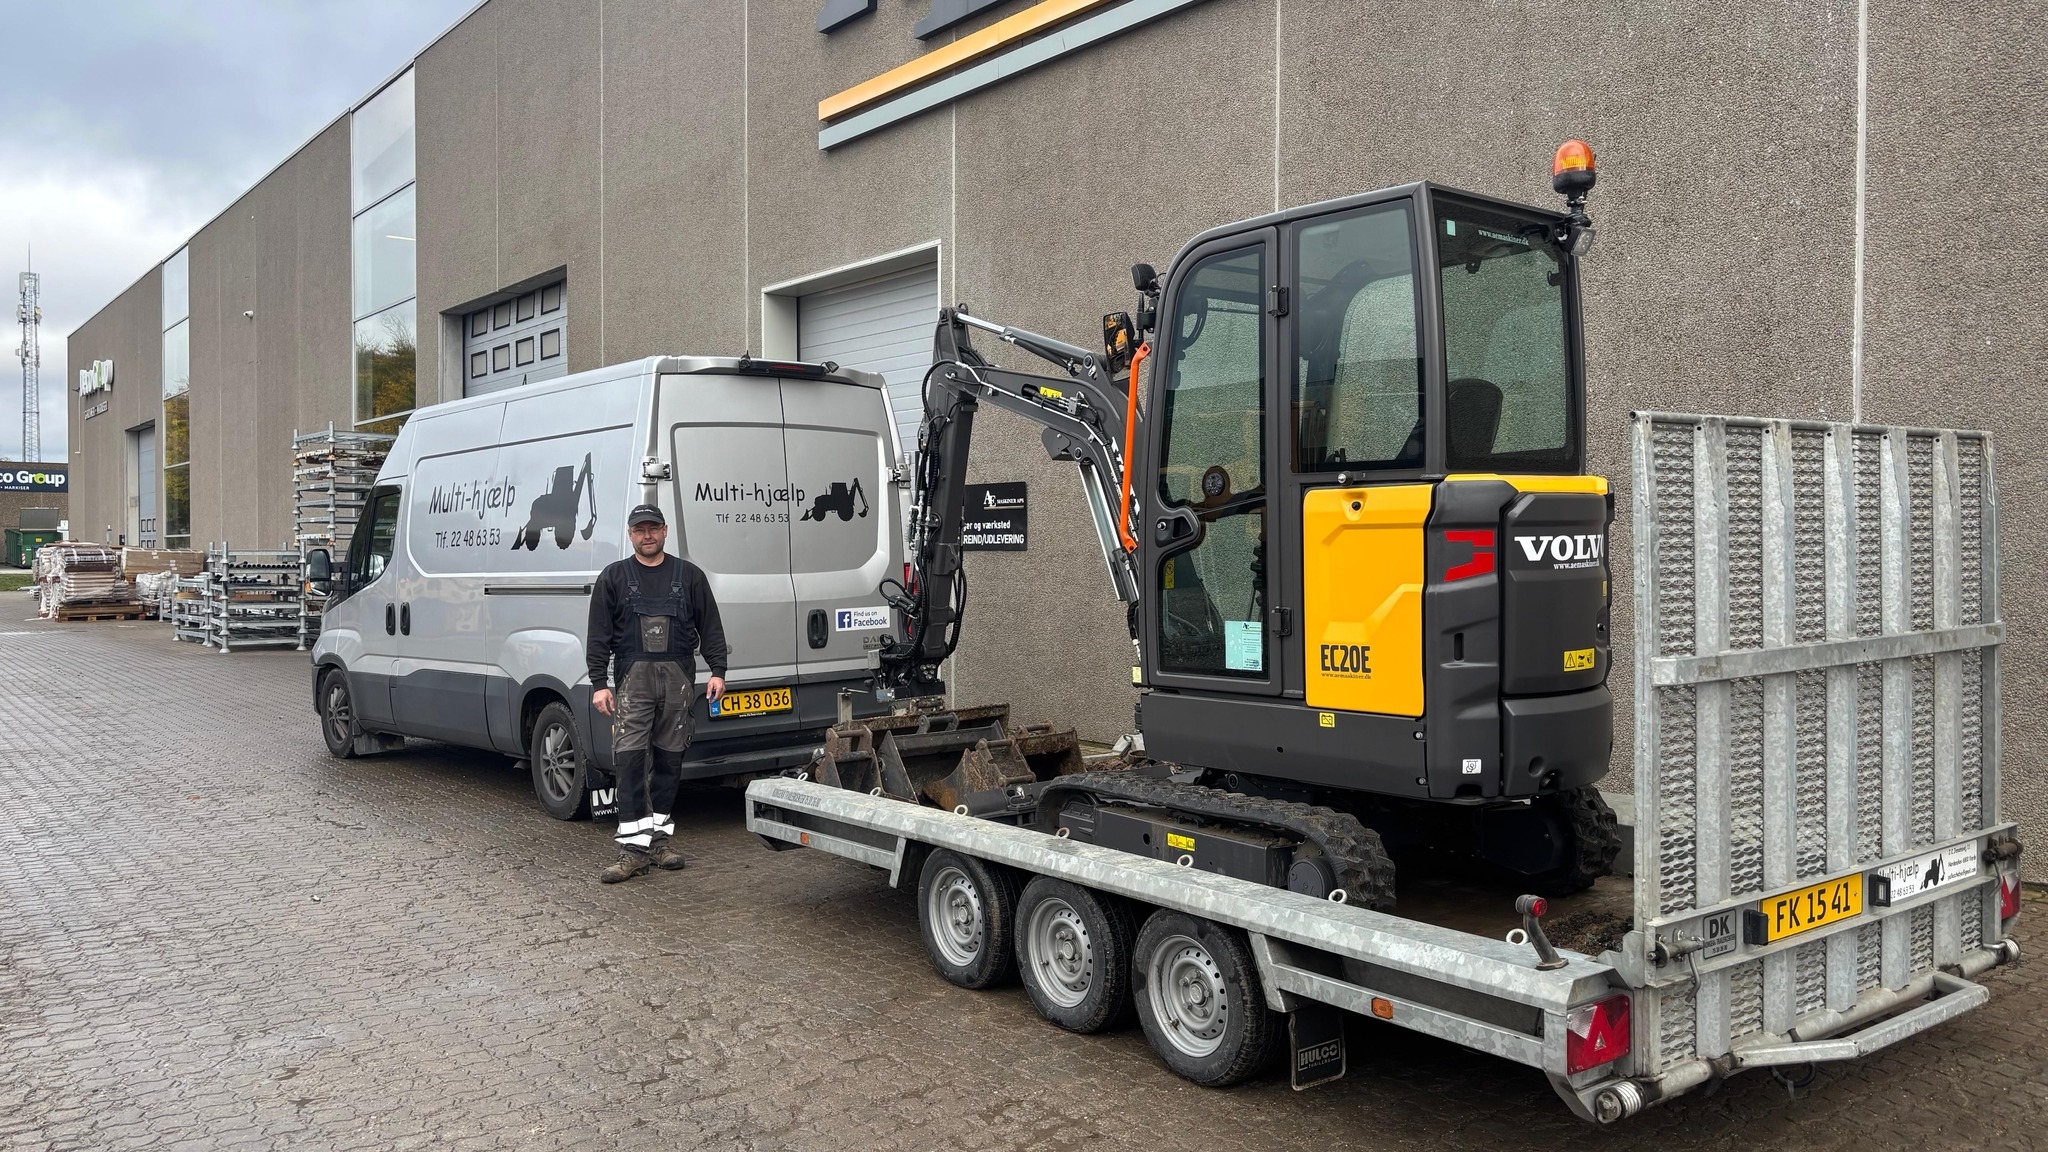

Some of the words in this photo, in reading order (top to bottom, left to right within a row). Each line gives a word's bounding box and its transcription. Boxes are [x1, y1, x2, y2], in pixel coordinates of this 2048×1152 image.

[16, 470, 66, 488] Group
[429, 475, 515, 520] Multi-hjælp
[695, 482, 805, 507] Multi-hjælp
[715, 513, 730, 523] Tlf
[735, 513, 747, 523] 22
[750, 513, 761, 523] 48
[764, 513, 775, 523] 63
[778, 513, 789, 523] 53
[973, 522, 982, 532] og
[982, 519, 1011, 530] værksted
[435, 531, 449, 549] Tlf.
[450, 530, 462, 547] 22
[463, 529, 474, 547] 48
[476, 529, 488, 547] 63
[489, 527, 501, 546] 53
[962, 533, 1025, 546] REIND/UDLEVERING
[853, 616, 888, 627] Facebook
[1320, 644, 1371, 674] EC20E
[721, 695, 741, 712] CH
[743, 693, 761, 709] 38
[764, 690, 790, 708] 036
[592, 787, 618, 807] IV
[1902, 885, 1909, 896] 63
[1908, 884, 1915, 894] 53
[1776, 895, 1801, 934] FK
[1807, 887, 1827, 924] 15
[1831, 881, 1851, 914] 41
[1709, 914, 1731, 940] DK
[1300, 1043, 1338, 1067] HULCO
